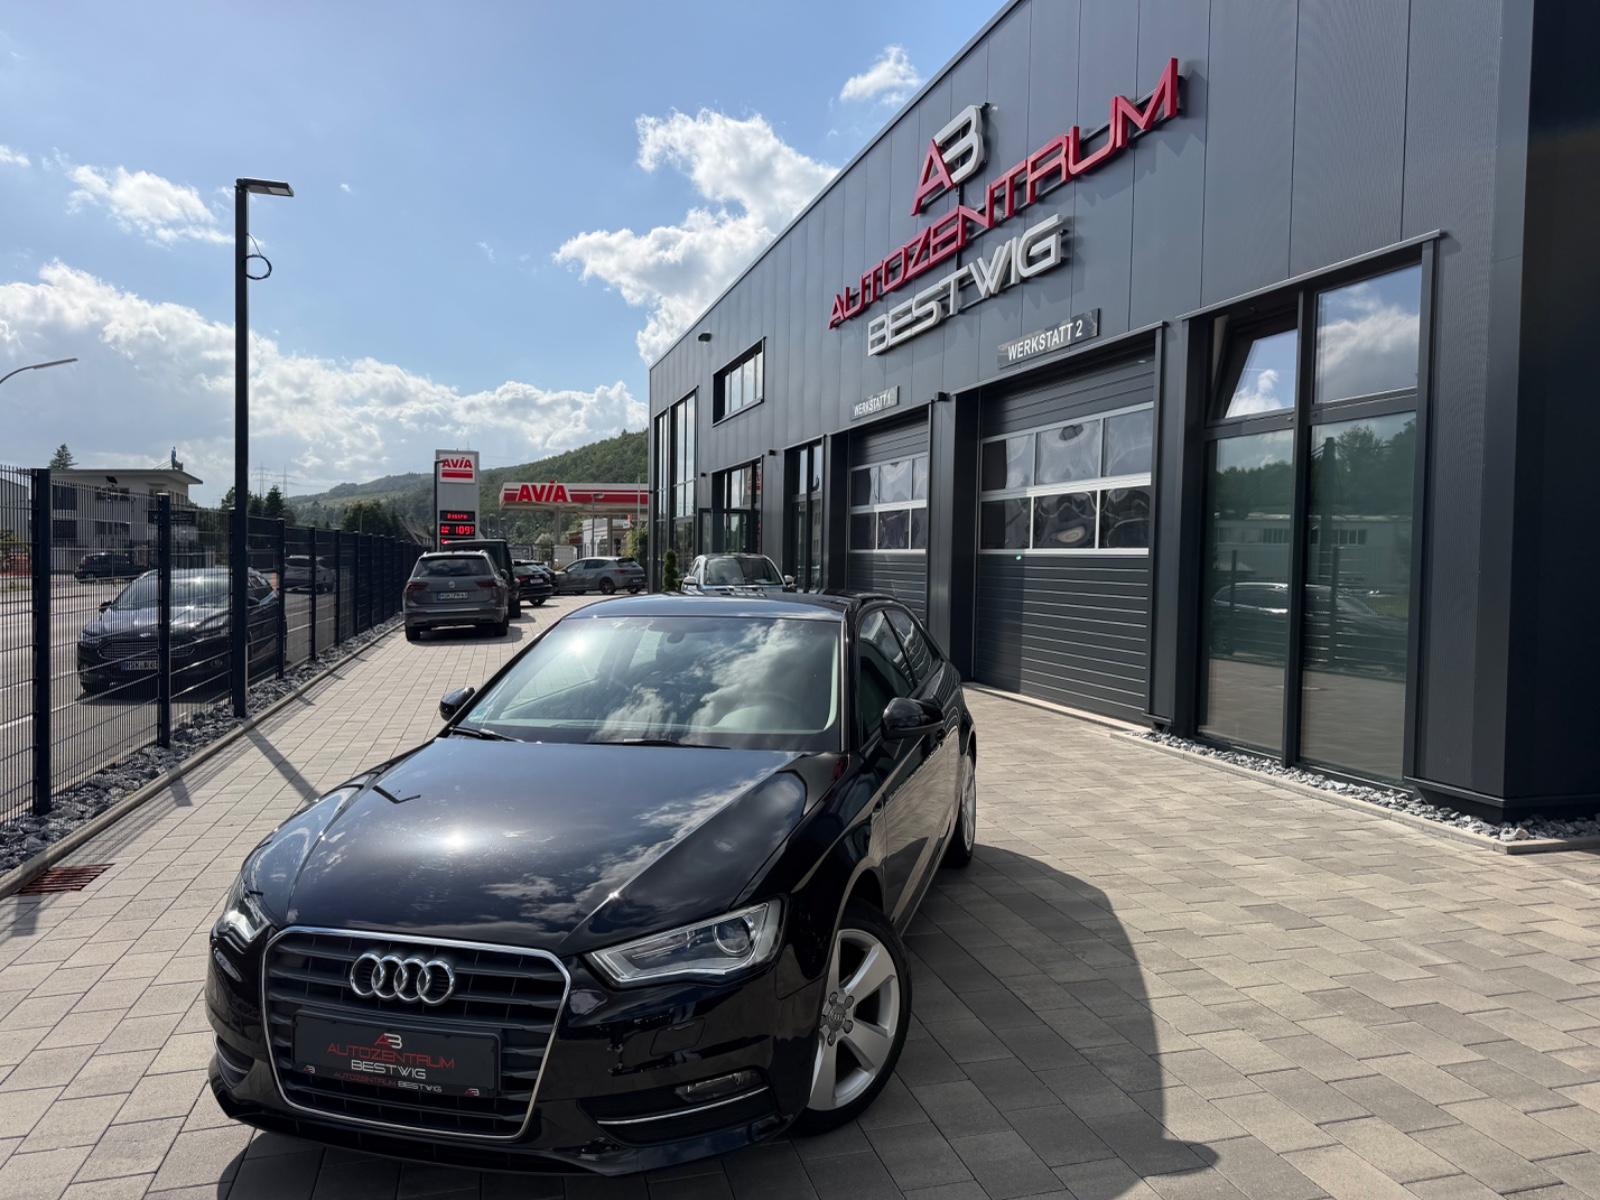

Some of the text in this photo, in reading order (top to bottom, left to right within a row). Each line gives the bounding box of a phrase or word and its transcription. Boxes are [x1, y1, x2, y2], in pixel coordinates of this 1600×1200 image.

[829, 57, 1180, 330] AUTOZENTRUM
[867, 213, 1065, 357] BESTWIG
[1007, 319, 1083, 361] WERKSTATT 2
[442, 456, 473, 470] AVIA
[517, 480, 569, 503] AVIA
[326, 1042, 456, 1069] AUTOZENTRUM
[351, 1059, 426, 1080] BESTWIG
